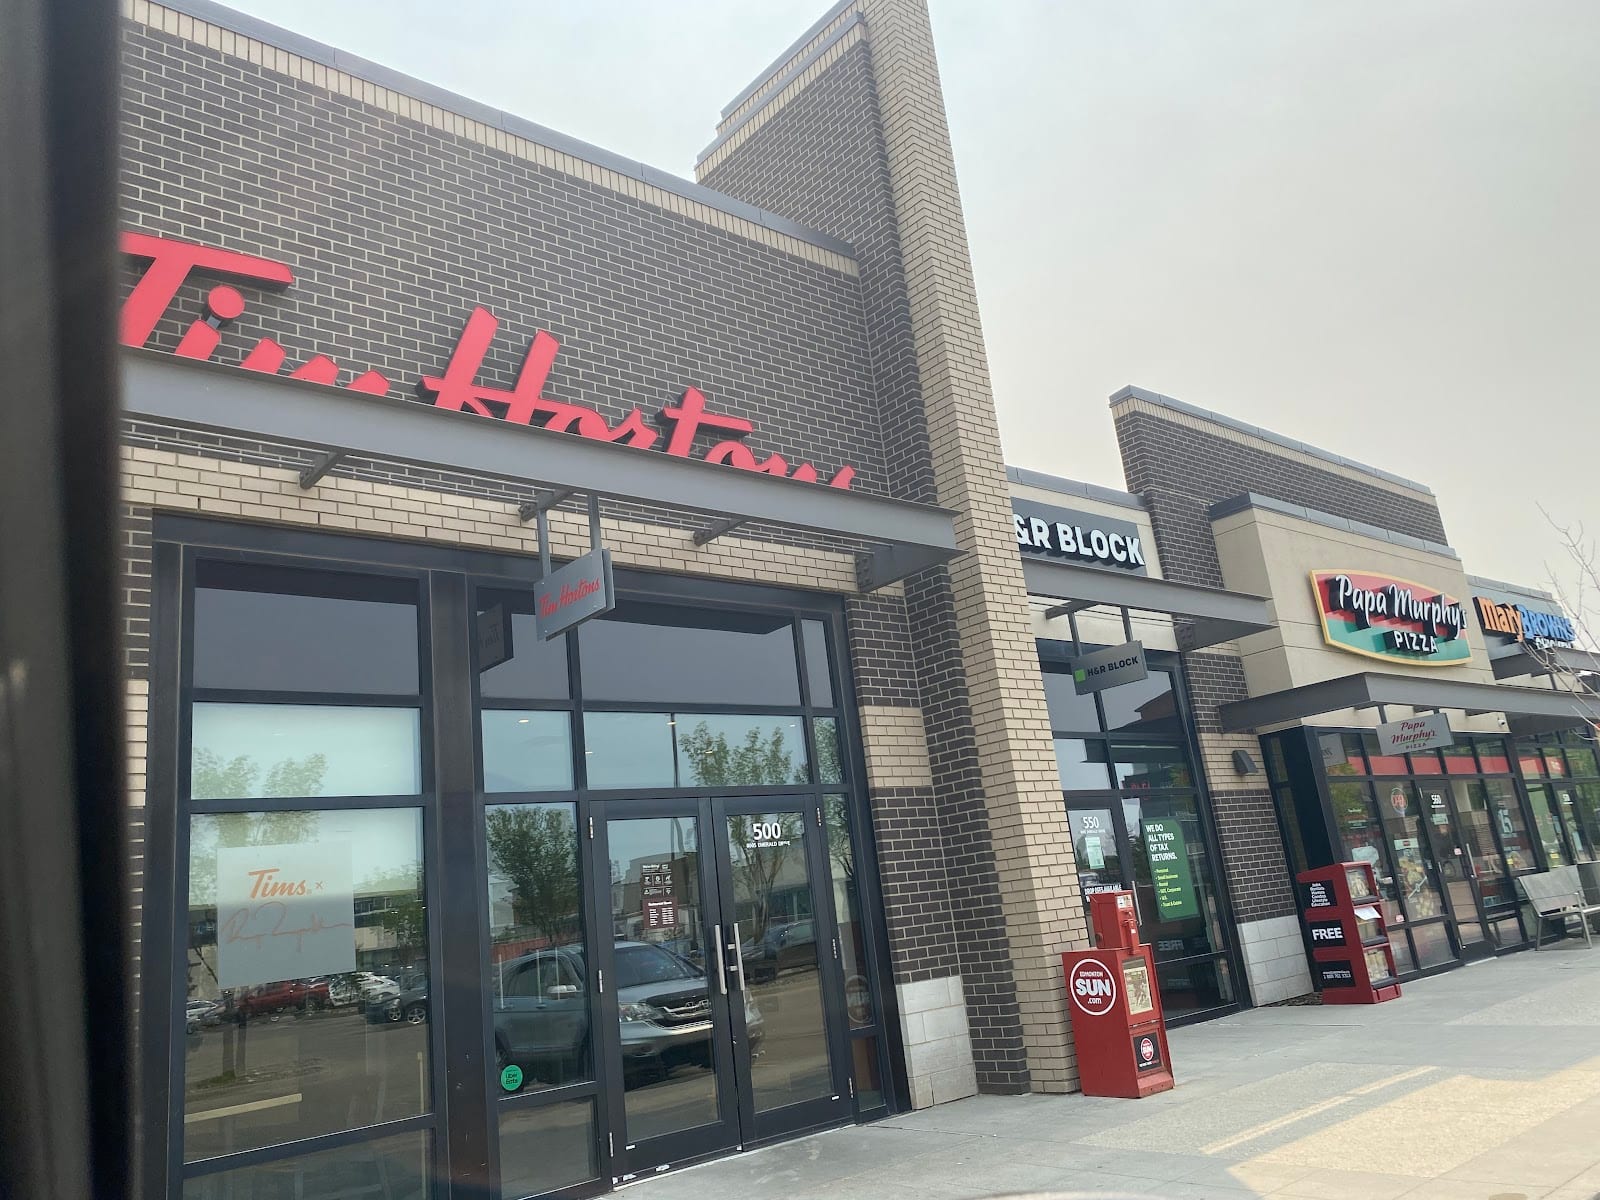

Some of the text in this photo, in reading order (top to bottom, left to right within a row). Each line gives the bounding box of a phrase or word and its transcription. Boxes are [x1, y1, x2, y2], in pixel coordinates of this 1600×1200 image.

[119, 231, 391, 396] Ti
[1056, 522, 1146, 566] BLOCK
[538, 576, 601, 619] Tim Hortons
[1336, 574, 1387, 627] Papa
[1394, 630, 1439, 653] PIZZA
[1086, 655, 1139, 678] H&R BLOCK
[1400, 721, 1426, 732] Papa
[1391, 729, 1436, 745] Murphy's
[1405, 742, 1427, 750] PIZZA
[1082, 815, 1100, 829] 550
[1145, 823, 1164, 832] WE DO
[752, 822, 781, 840] 500
[1148, 832, 1175, 842] ALL TYPES
[1150, 842, 1169, 852] OF TAX
[248, 868, 307, 899] Tims
[1312, 927, 1343, 940] FREE
[1075, 979, 1111, 996] SUN
